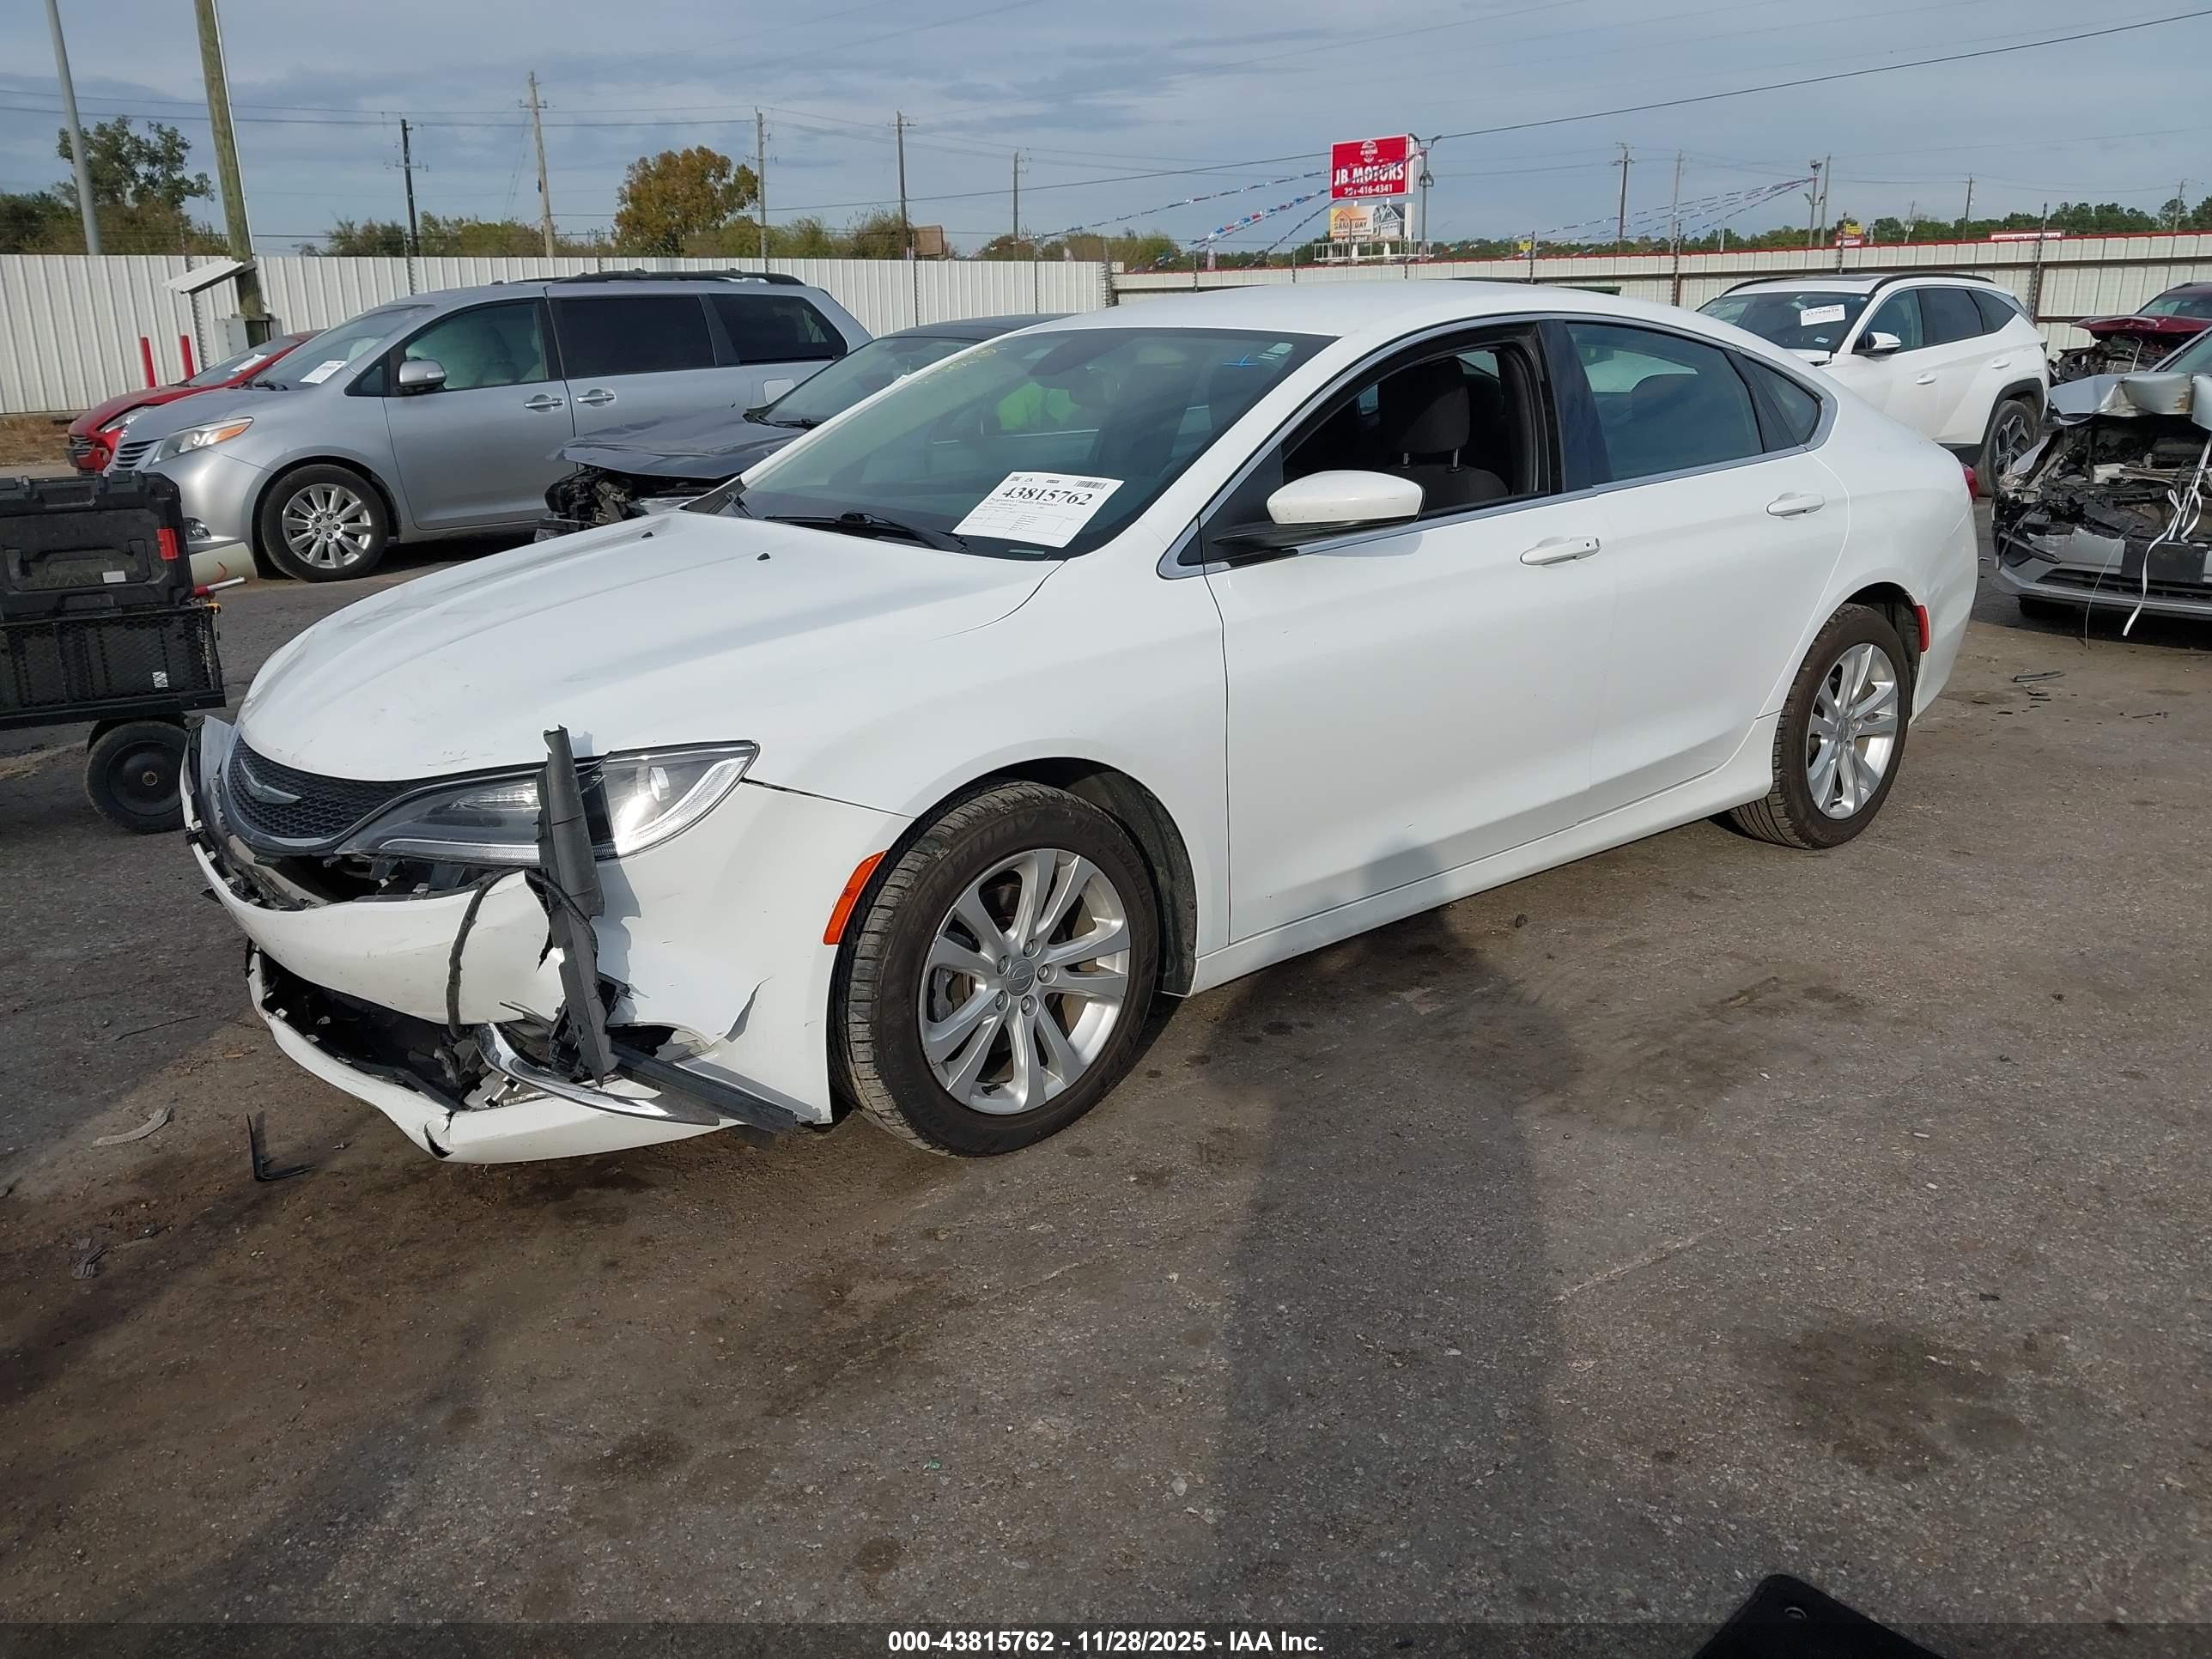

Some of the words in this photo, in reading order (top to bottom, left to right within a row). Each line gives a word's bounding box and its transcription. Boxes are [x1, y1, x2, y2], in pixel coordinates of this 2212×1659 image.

[1334, 168, 1348, 185] JB
[1352, 163, 1404, 183] MOTORS
[1002, 486, 1093, 506] 43815762
